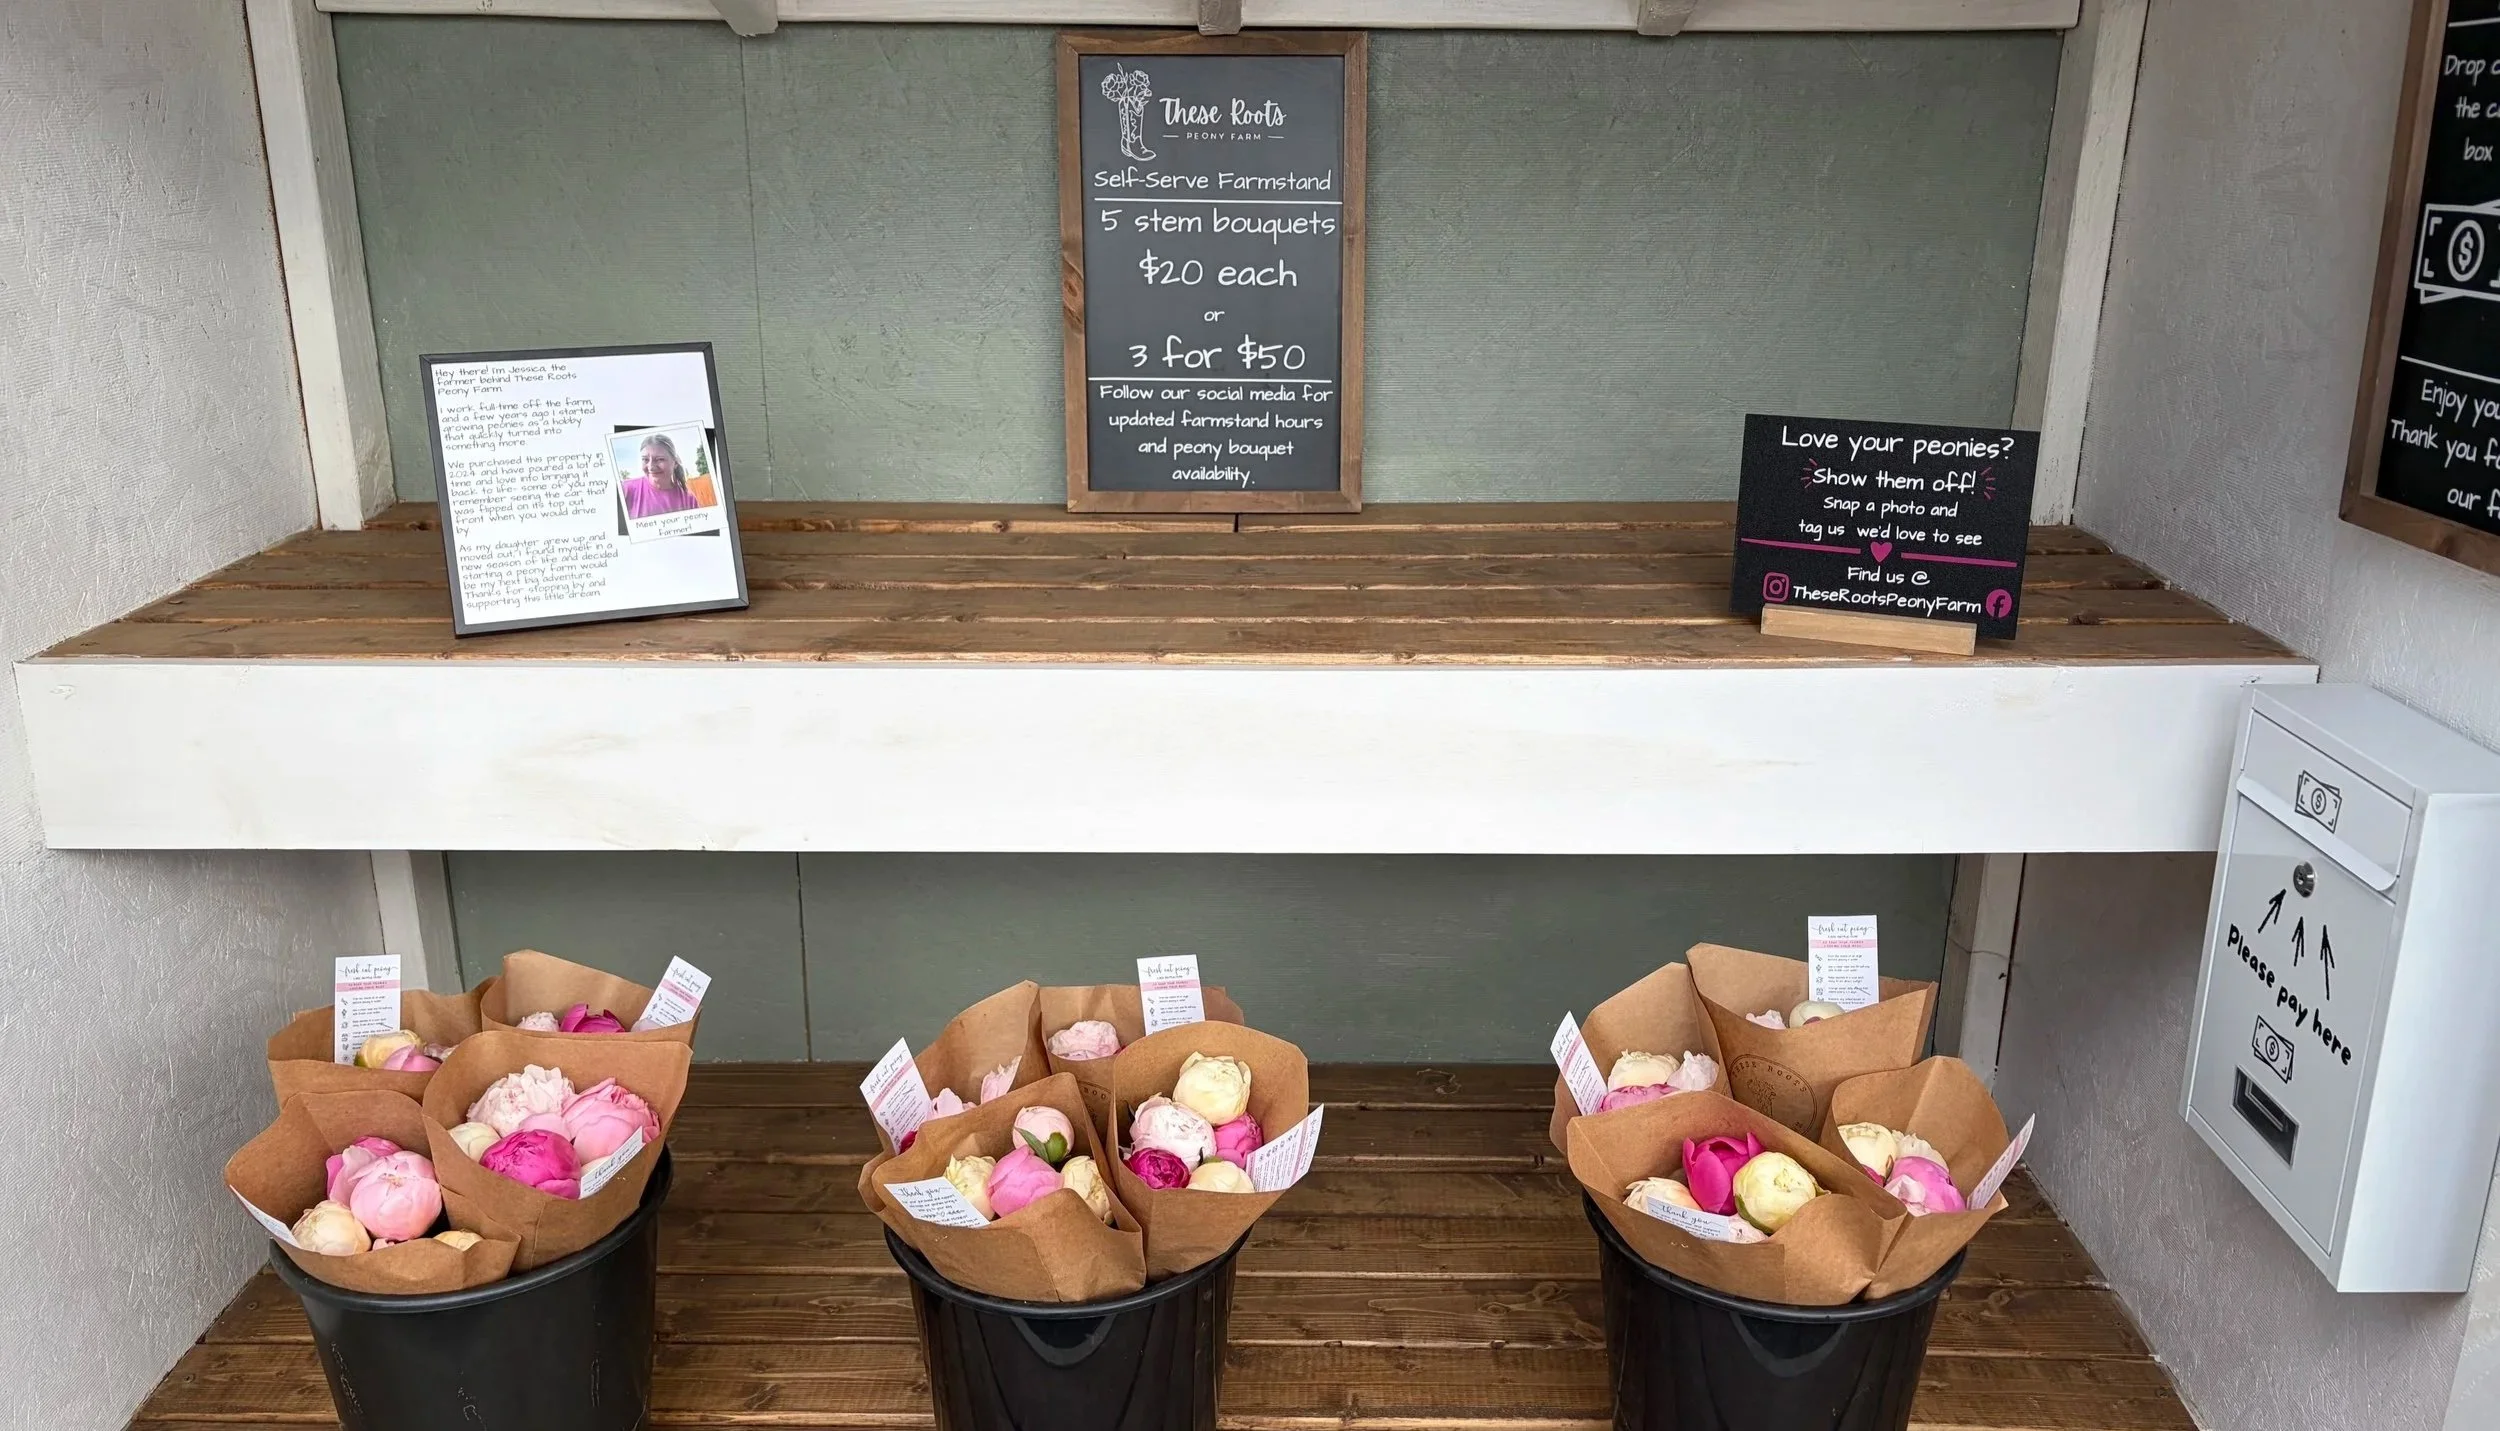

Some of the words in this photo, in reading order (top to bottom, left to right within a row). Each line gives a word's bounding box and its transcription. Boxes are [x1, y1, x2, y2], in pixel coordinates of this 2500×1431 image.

[2443, 54, 2487, 87] Drop
[1159, 97, 1222, 126] These
[1230, 97, 1287, 127] Roots
[2455, 95, 2481, 119] the
[1186, 132, 1225, 140] PEONY
[1230, 133, 1261, 141] FARM
[2463, 136, 2494, 162] box
[1093, 165, 1209, 189] Self-Serve
[1218, 168, 1332, 191] Farmstand
[1101, 208, 1123, 231] 5
[1134, 208, 1202, 233] stem
[1213, 207, 1336, 245] bouquets
[1138, 248, 1203, 286] $20
[1217, 258, 1298, 287] each
[1203, 310, 1226, 323] or
[1128, 344, 1149, 368] 3
[1162, 334, 1223, 369] for
[1236, 333, 1306, 371] $50
[435, 368, 455, 380] Hey
[460, 364, 489, 376] there!
[508, 365, 547, 374] Jessica
[551, 363, 567, 372] the
[437, 376, 477, 386] farmer
[479, 374, 511, 384] behind
[514, 374, 544, 382] These
[547, 371, 577, 381] Roots
[437, 387, 470, 398] Peony
[1099, 384, 1154, 401] Follow
[1160, 387, 1191, 400] our
[1196, 386, 1243, 401] social
[1249, 384, 1297, 402] media
[1301, 384, 1334, 403] for
[2421, 378, 2468, 424] Enjoy
[441, 413, 459, 423] and
[473, 411, 495, 421] few
[498, 411, 528, 423] years
[531, 410, 550, 421] ago
[558, 405, 596, 416] started
[446, 404, 475, 414] work
[522, 398, 542, 409] off
[545, 399, 562, 408] the
[442, 424, 485, 434] growing
[487, 421, 524, 433] peonies
[552, 416, 582, 429] hobby
[1108, 409, 1175, 433] updated
[1180, 409, 1270, 429] farmstand
[1275, 413, 1323, 430] hours
[444, 432, 465, 442] that
[468, 430, 504, 442] quickly
[507, 426, 541, 438] turned
[543, 426, 563, 435] into
[1781, 425, 1839, 449] Love
[1848, 435, 1904, 462] your
[1912, 436, 2015, 465] peonies?
[2390, 418, 2439, 450] Thank
[2444, 439, 2478, 469] you
[445, 440, 496, 452] something
[1137, 436, 1167, 454] and
[1172, 440, 1223, 462] peony
[1228, 438, 1295, 462] bouquet
[447, 460, 465, 470] We
[468, 455, 523, 471] purchased
[525, 455, 543, 464] this
[546, 451, 593, 465] property
[480, 466, 499, 476] and
[501, 466, 525, 475] have
[528, 461, 564, 474] poured
[576, 460, 589, 469] lot
[593, 458, 606, 468] of
[1171, 464, 1256, 489] availability.
[1812, 467, 1868, 487] Show
[1875, 470, 1925, 491] them
[1932, 469, 1977, 495] off!
[452, 495, 507, 507] remember
[510, 493, 542, 503] seeing
[544, 490, 560, 499] the
[564, 490, 583, 498] car
[586, 487, 606, 496] that
[1823, 496, 1861, 517] Snap
[1865, 501, 1876, 513] a
[1880, 498, 1926, 520] photo
[1930, 501, 1959, 518] and
[2446, 488, 2482, 511] our
[455, 514, 485, 525] front
[488, 513, 515, 522] when
[518, 512, 537, 524] you
[540, 506, 569, 518] would
[571, 506, 597, 516] drive
[635, 519, 658, 529] Meet
[660, 515, 681, 528] your
[683, 512, 709, 524] peony
[459, 544, 473, 553] As
[475, 543, 492, 555] my
[494, 539, 541, 552] daughter
[543, 537, 570, 549] grew
[572, 535, 586, 546] up
[588, 531, 606, 541] and
[1798, 518, 1823, 542] tag
[1827, 523, 1846, 536] us
[1856, 522, 1891, 540] we'd
[1895, 525, 1927, 542] love
[1932, 528, 1950, 544] to
[1954, 532, 1983, 547] see
[1847, 565, 1881, 583] Find
[1885, 571, 1905, 584] us
[1910, 570, 1932, 586] @
[464, 588, 502, 600] Thanks
[505, 585, 525, 595] for
[528, 583, 570, 595] stopping
[572, 580, 586, 592] by
[588, 577, 606, 588] and
[466, 597, 521, 612] supporting
[523, 594, 541, 604] this
[544, 591, 565, 601] little
[1792, 584, 1983, 618] TheseRootsPeonyFarm
[2227, 922, 2276, 989] Please
[2276, 985, 2309, 1028] pay
[2312, 1007, 2352, 1066] here
